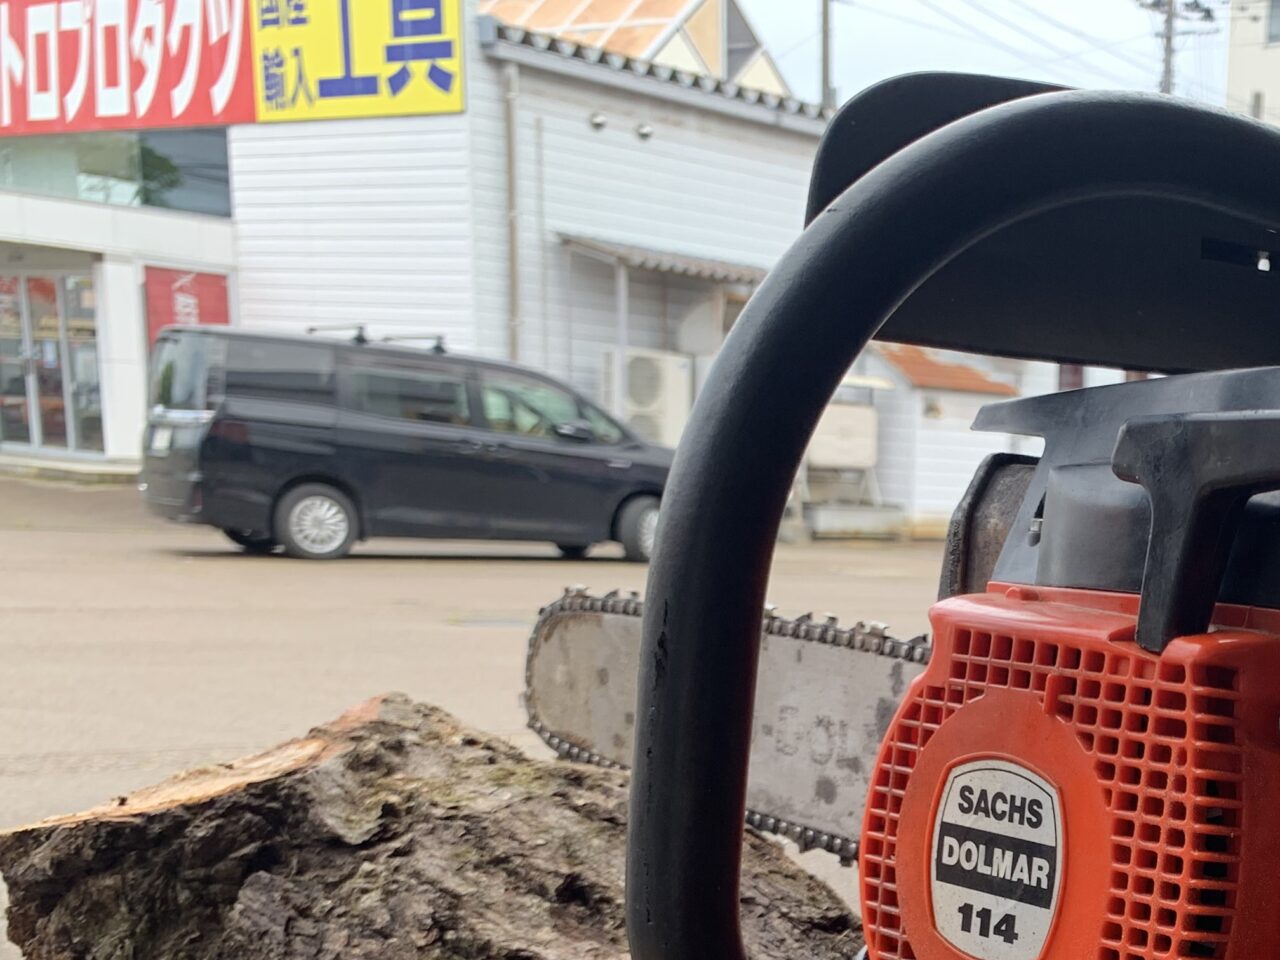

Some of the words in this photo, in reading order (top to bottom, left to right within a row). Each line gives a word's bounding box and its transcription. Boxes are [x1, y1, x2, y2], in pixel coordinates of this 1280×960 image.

[957, 784, 1044, 829] SACHS
[941, 836, 1050, 889] DOLMAR
[957, 903, 1019, 944] 114
